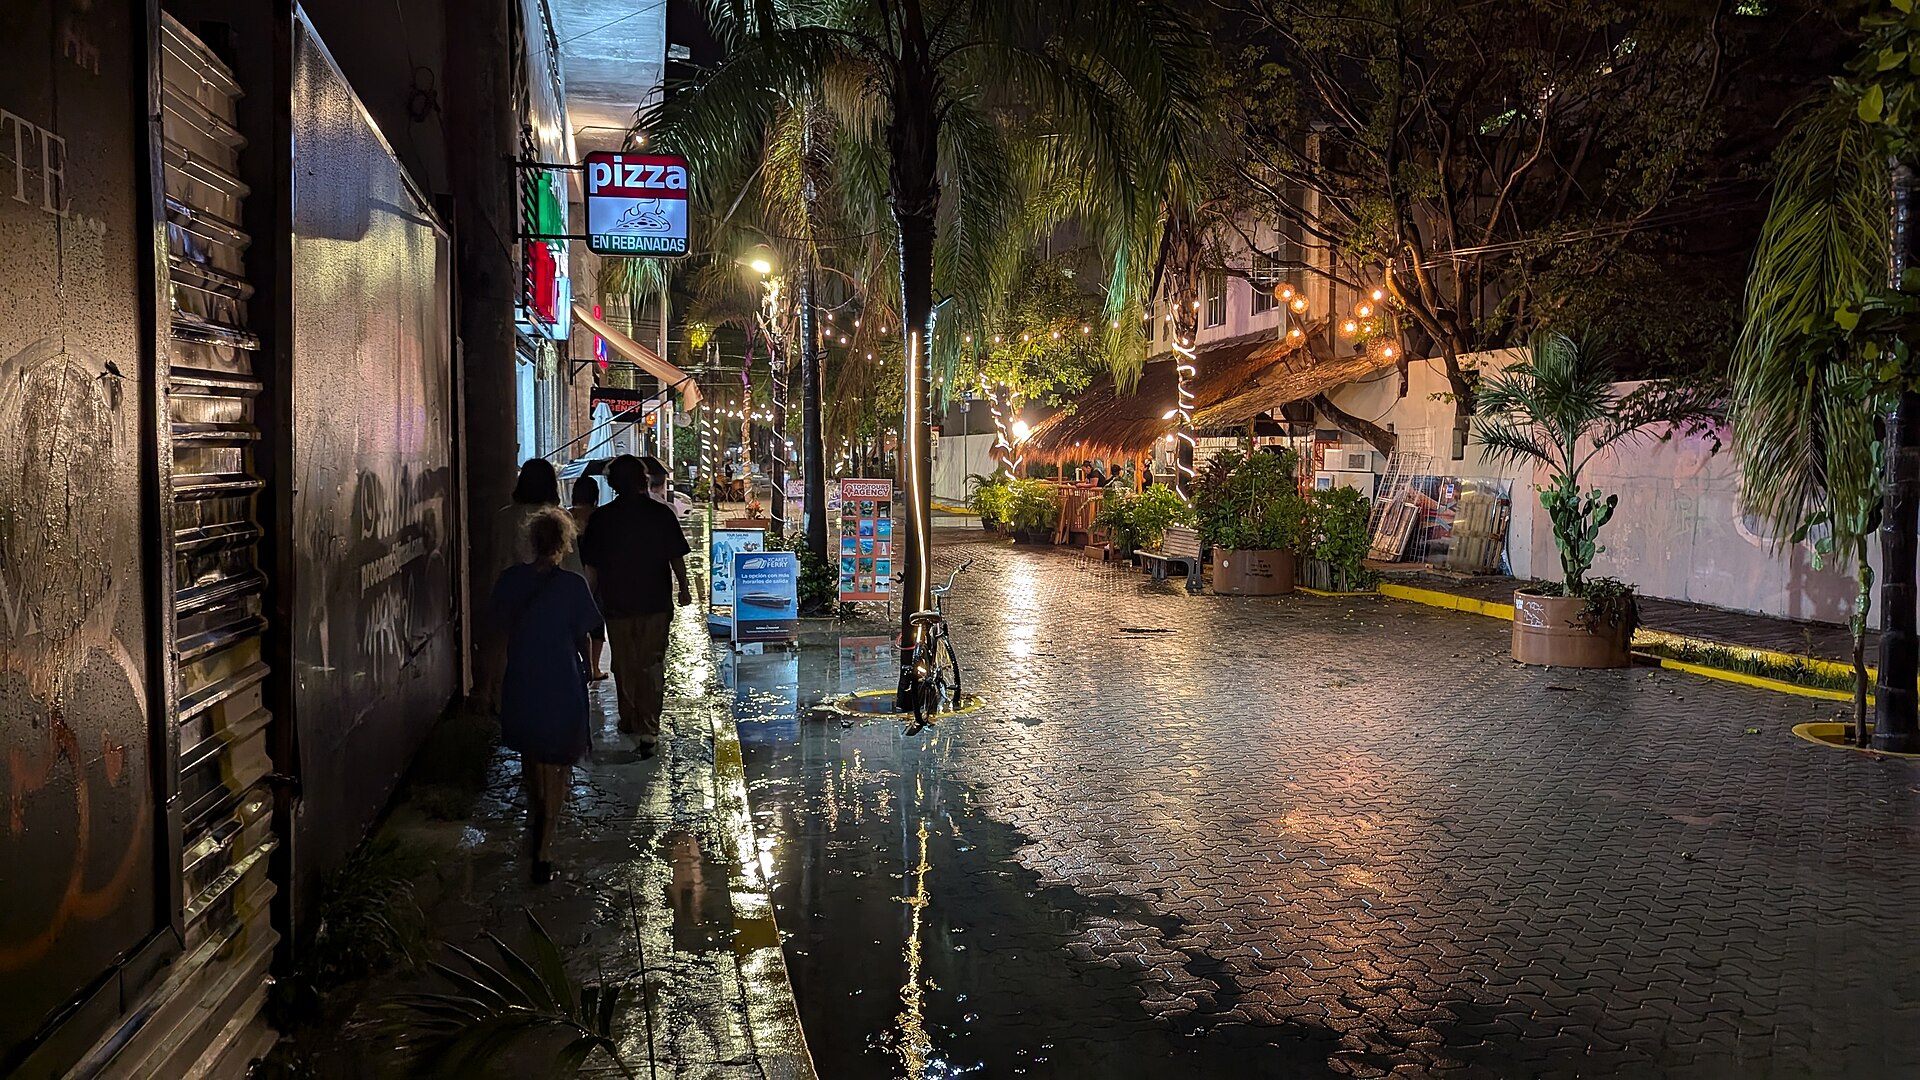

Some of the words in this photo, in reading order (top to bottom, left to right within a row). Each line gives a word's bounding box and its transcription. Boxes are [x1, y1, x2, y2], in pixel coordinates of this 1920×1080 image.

[589, 155, 687, 193] pizza
[592, 235, 610, 249] EN
[612, 236, 686, 252] REBANADAS
